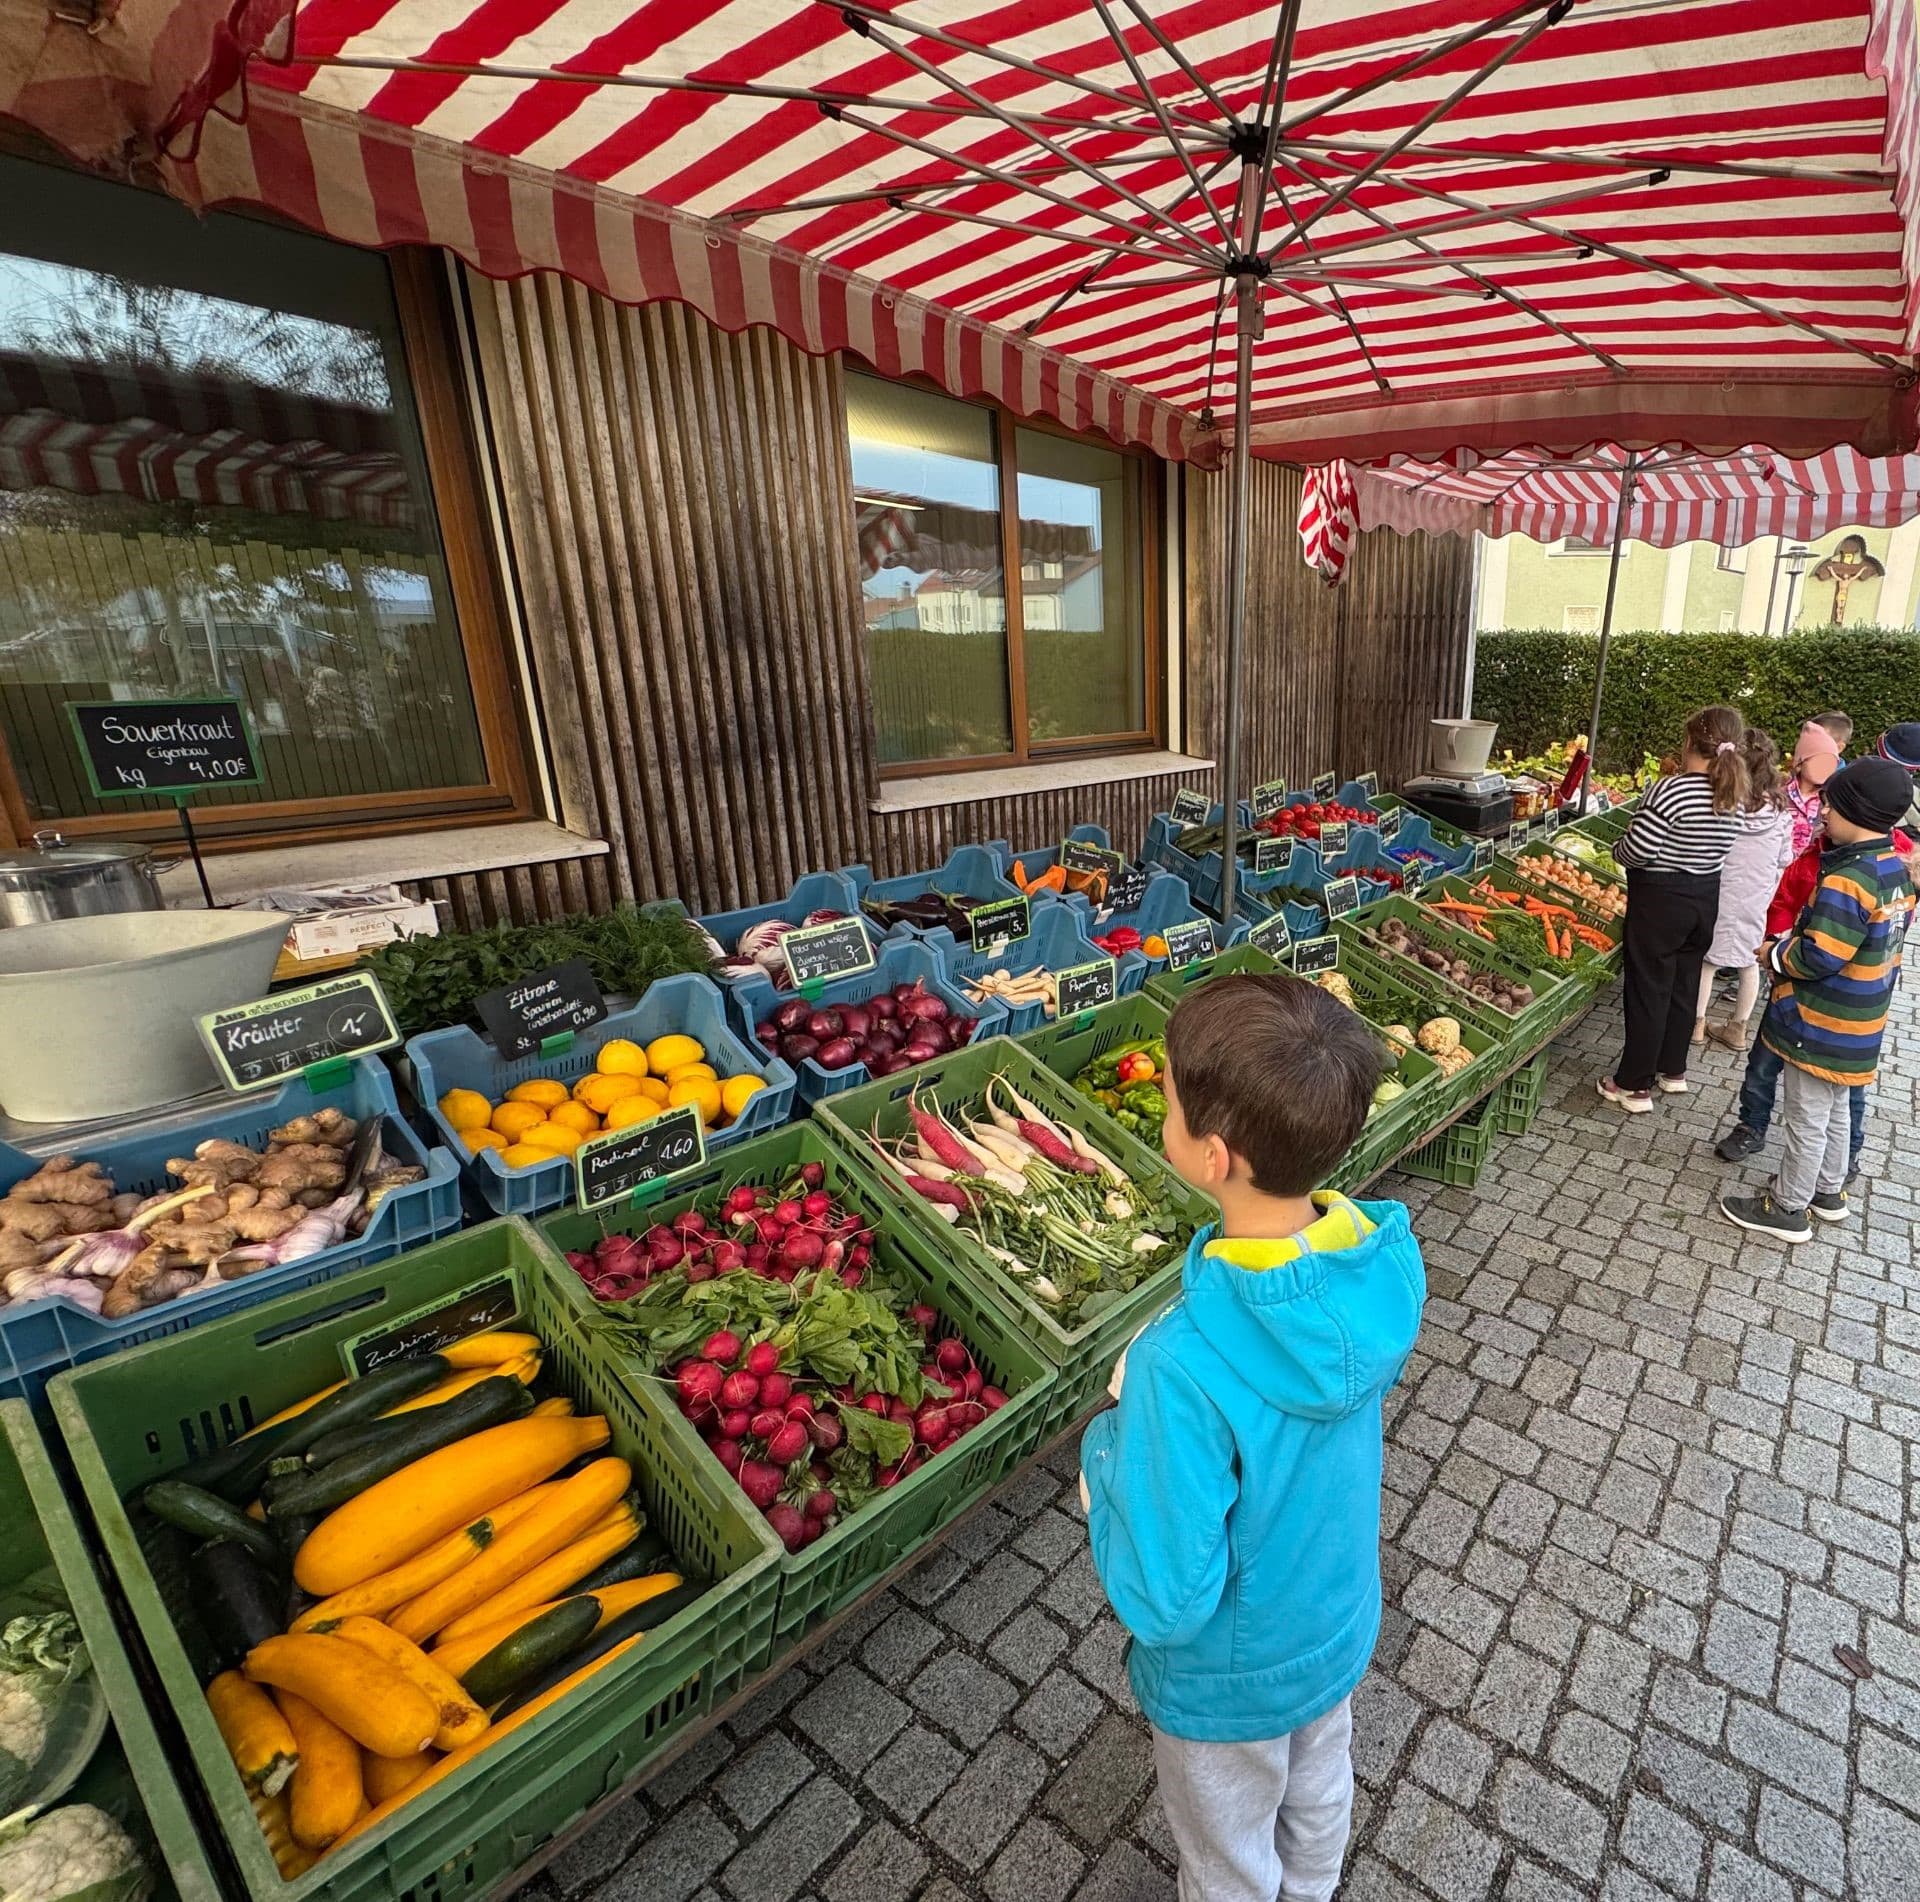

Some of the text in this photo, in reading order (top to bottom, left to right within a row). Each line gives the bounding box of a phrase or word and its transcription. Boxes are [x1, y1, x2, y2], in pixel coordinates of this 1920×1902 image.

[102, 715, 235, 744] Sauerkraut
[146, 747, 210, 765] Eigenbau
[116, 766, 146, 788] kg
[350, 922, 386, 934] PERFECT
[215, 978, 362, 1025] Aus eigenem Anbau
[505, 980, 559, 1010] Zitrone
[227, 1017, 303, 1051] Kräuter
[586, 1140, 608, 1154] Aus
[657, 1107, 690, 1125] Anbau
